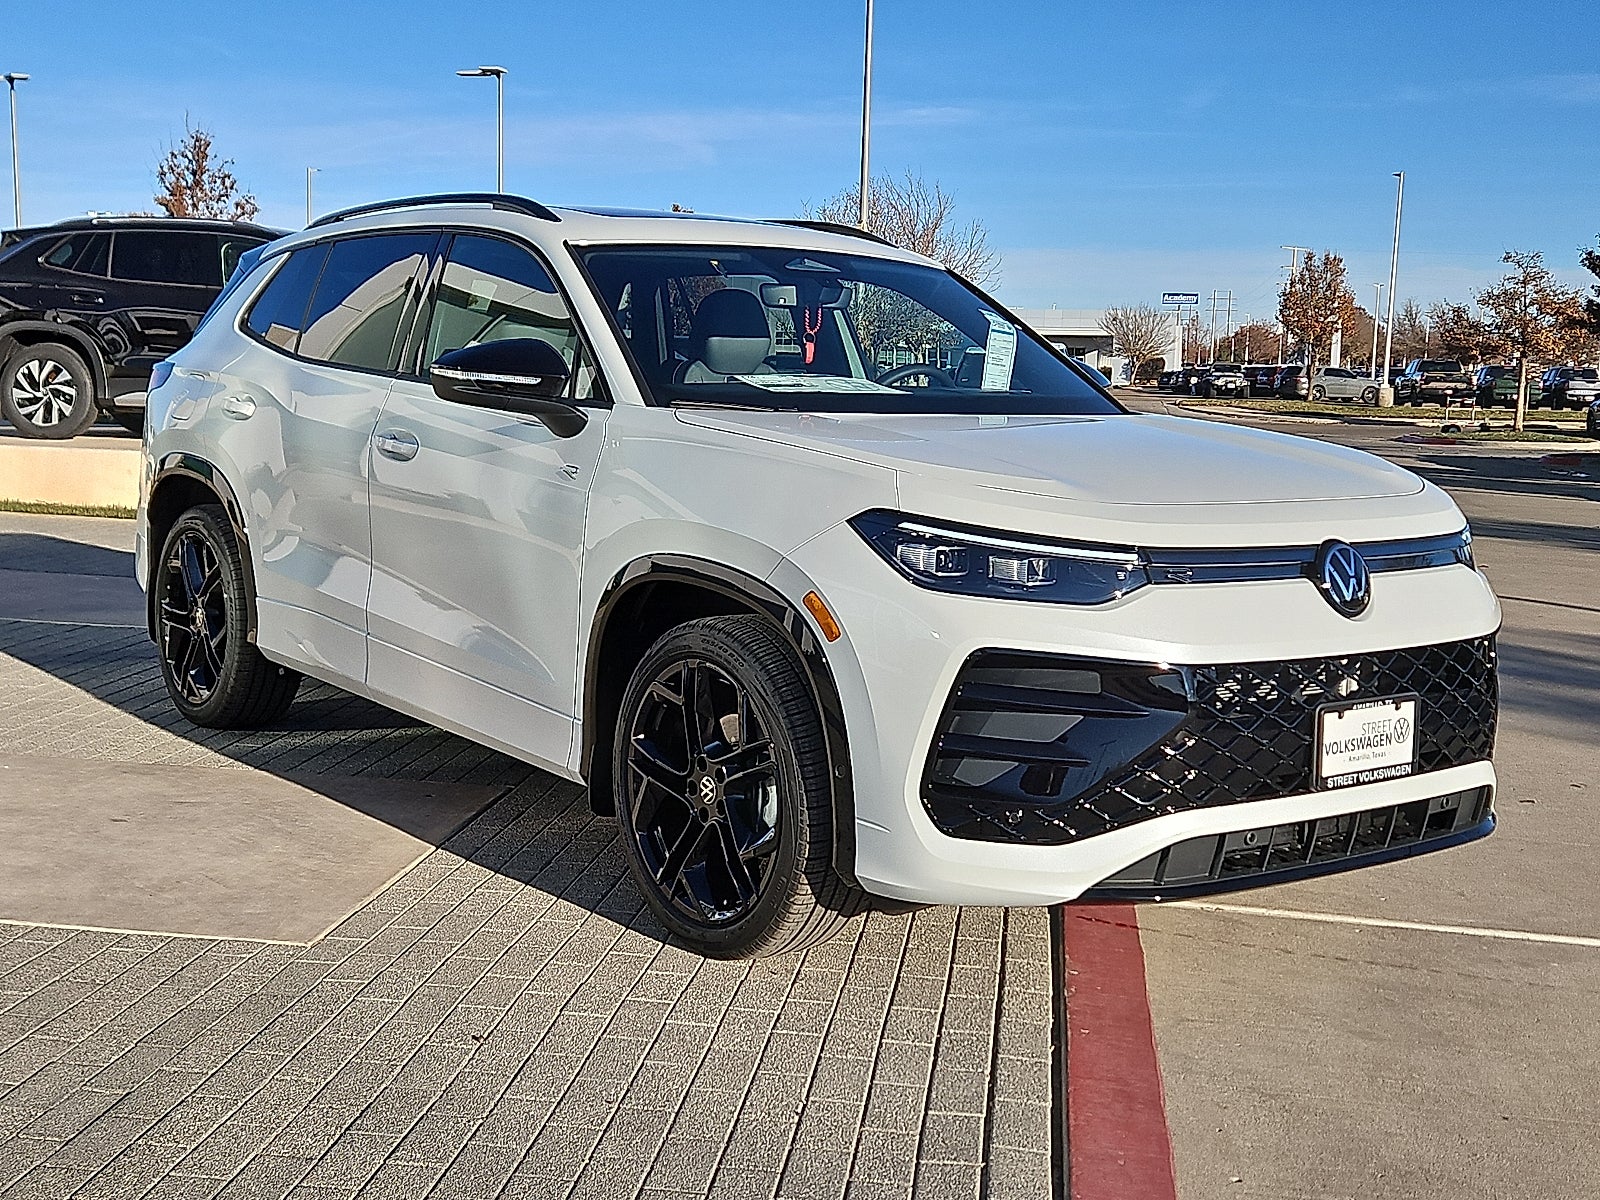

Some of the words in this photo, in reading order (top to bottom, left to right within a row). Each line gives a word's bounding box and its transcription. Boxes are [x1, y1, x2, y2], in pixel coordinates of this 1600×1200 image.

[1164, 294, 1198, 303] Academy
[1361, 719, 1392, 736] STREET
[1324, 732, 1393, 756] VOLKSWAGEN
[1327, 773, 1358, 788] STREET
[1358, 764, 1412, 782] VOLKSWAGEN
